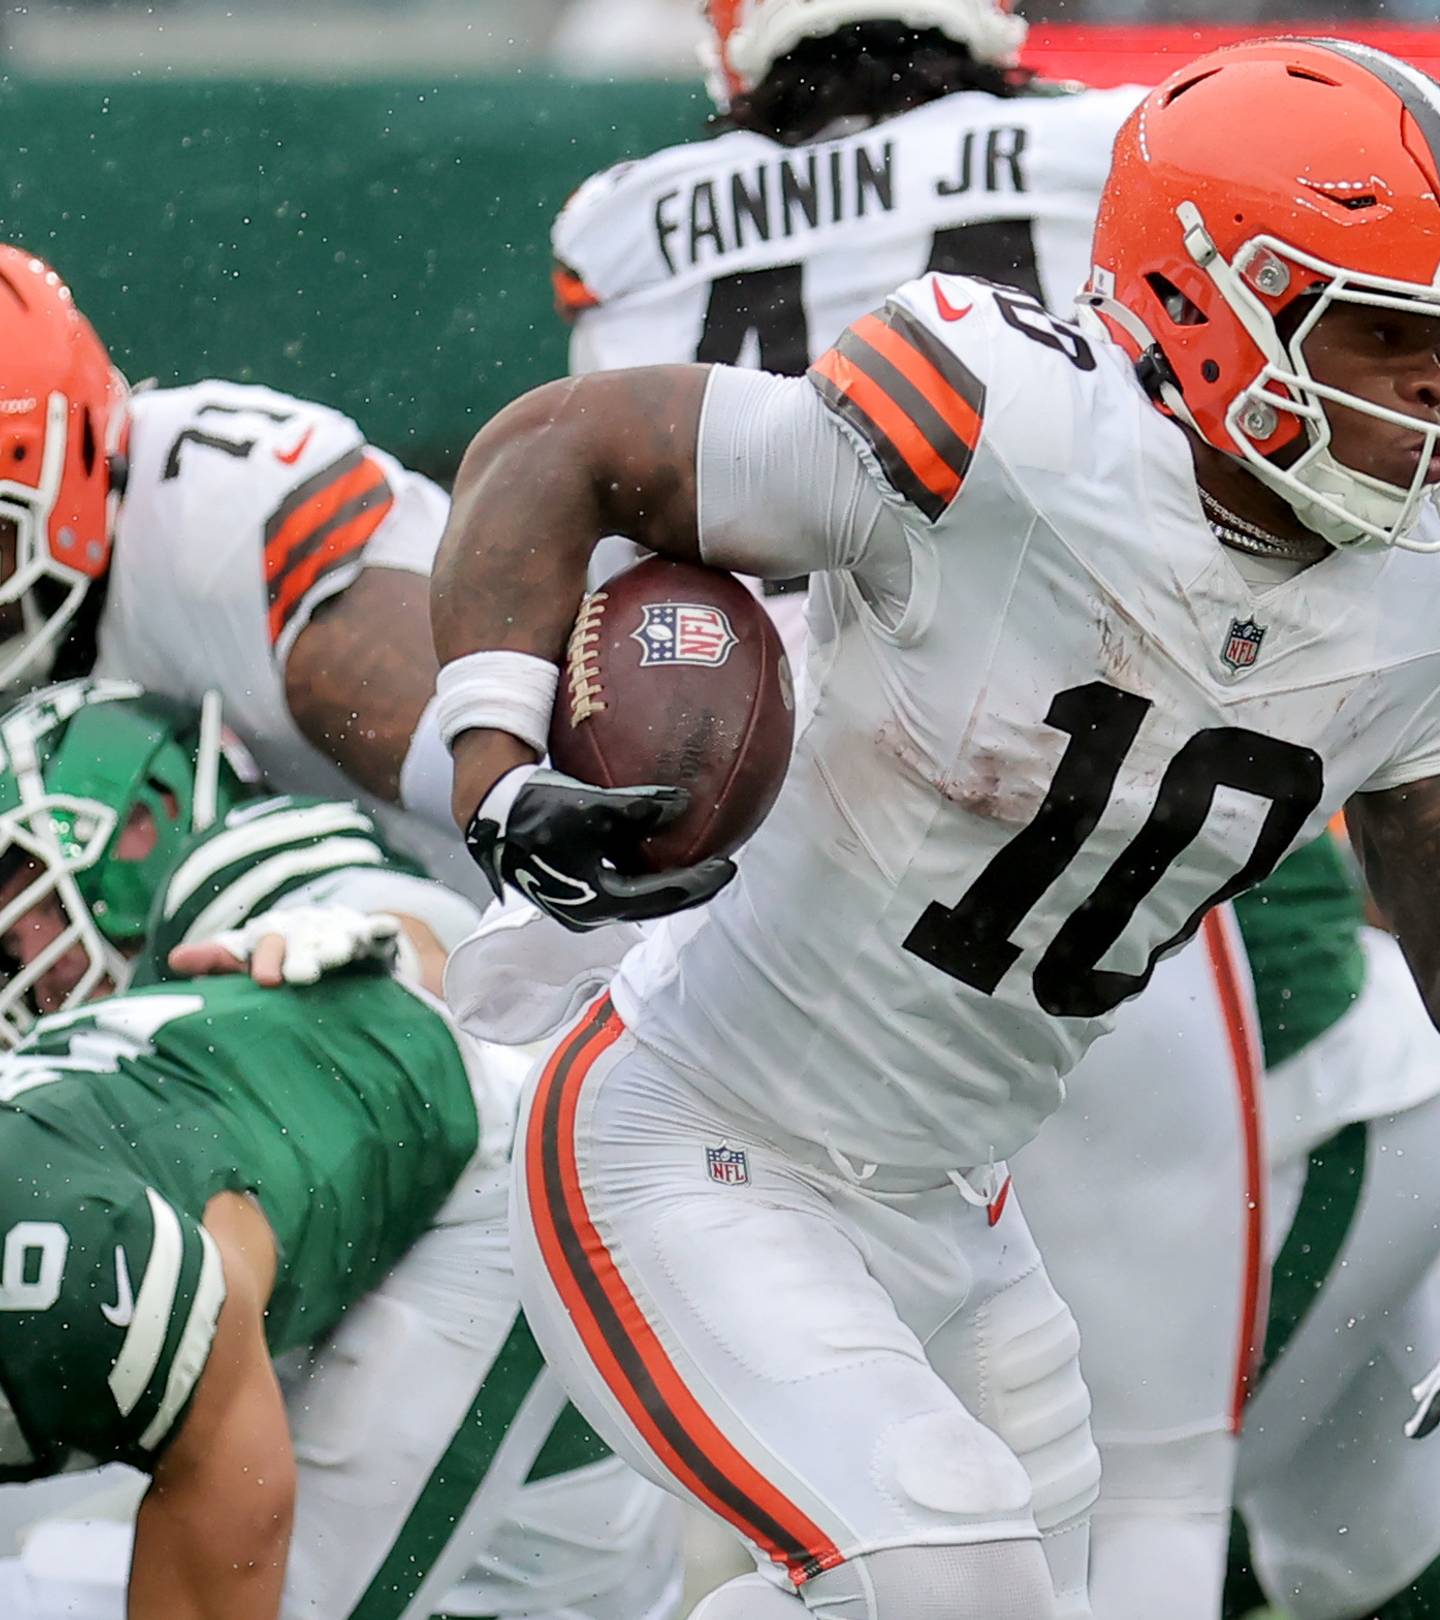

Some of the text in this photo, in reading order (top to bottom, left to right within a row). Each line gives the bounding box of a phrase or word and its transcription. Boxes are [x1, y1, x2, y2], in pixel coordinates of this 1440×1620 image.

[655, 127, 1028, 275] FANNIN JR
[679, 610, 725, 659] NFL
[902, 680, 1325, 1018] 10
[711, 1161, 746, 1183] NFL
